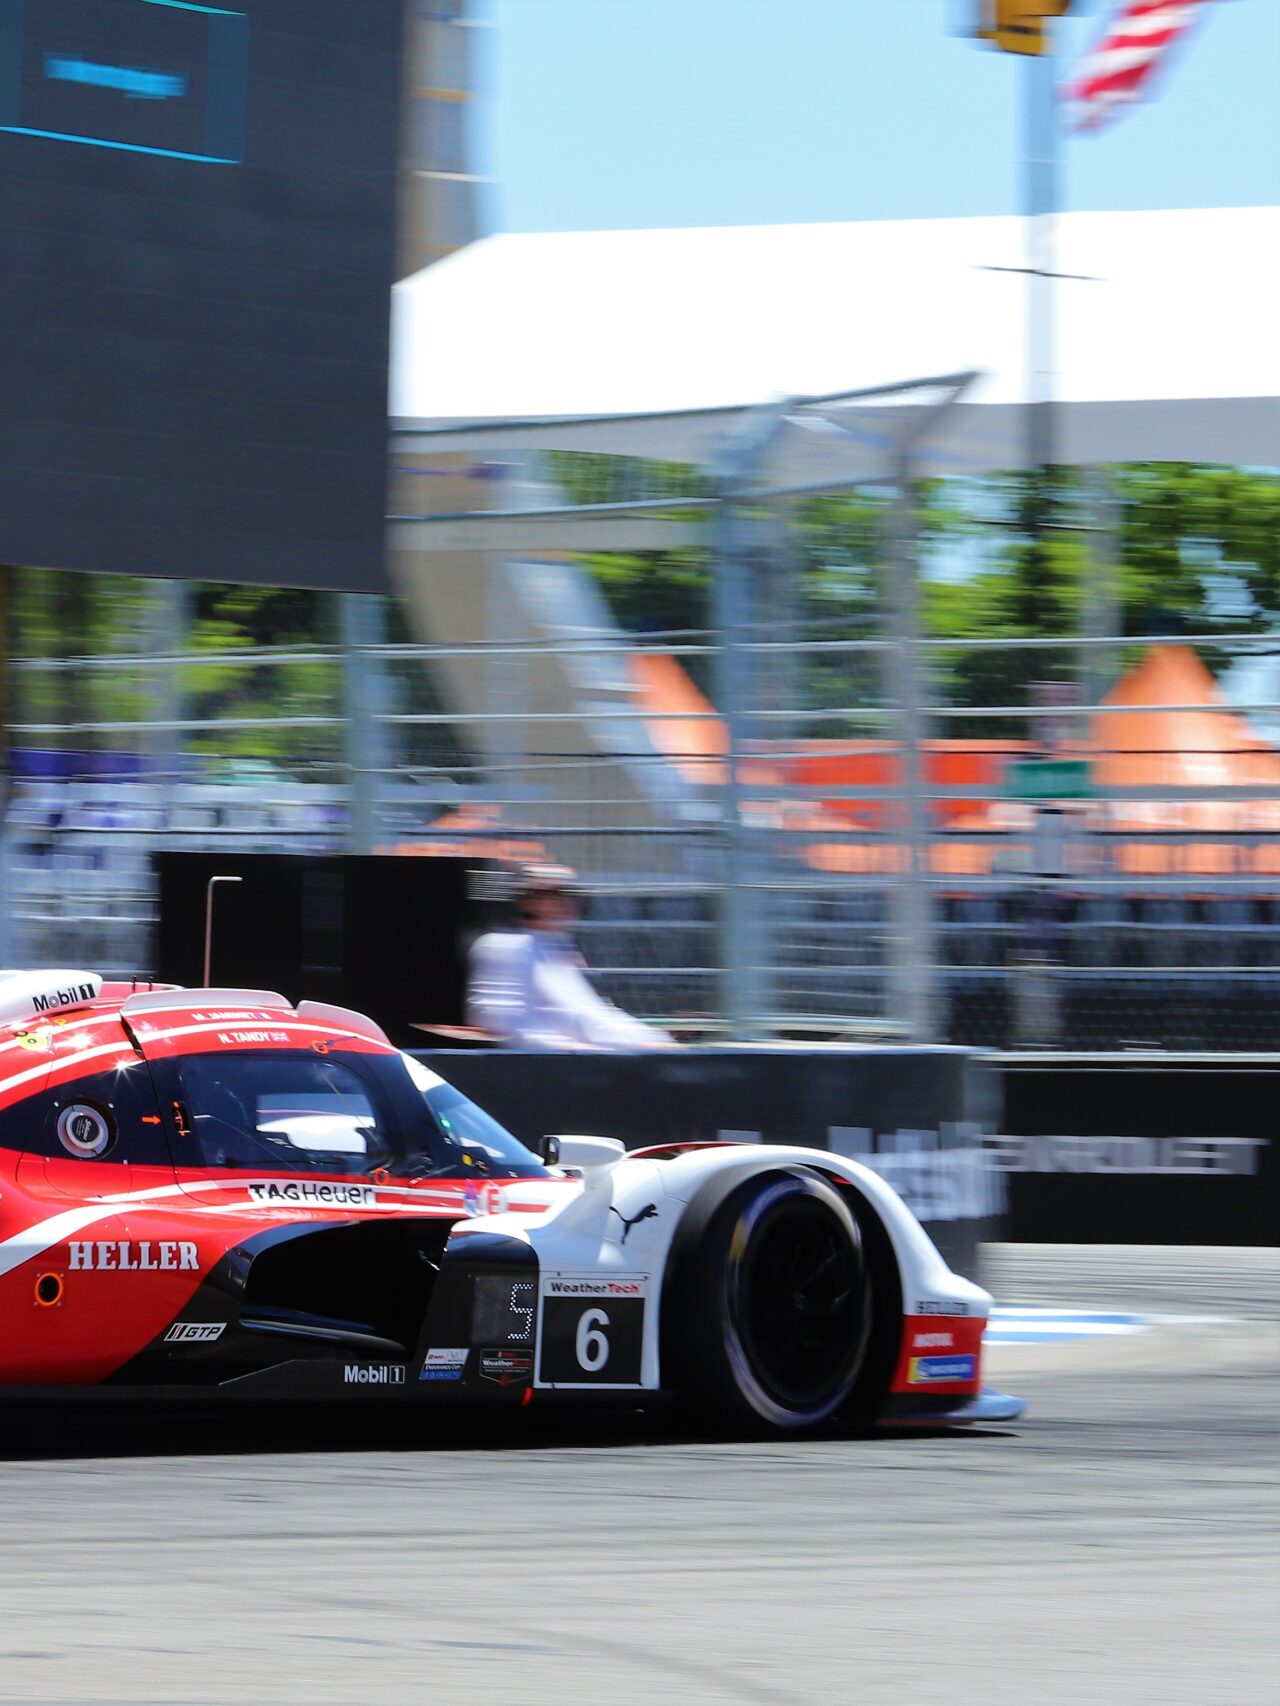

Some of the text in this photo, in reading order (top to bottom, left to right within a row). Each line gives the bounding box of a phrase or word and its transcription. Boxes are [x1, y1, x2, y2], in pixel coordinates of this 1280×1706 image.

[32, 988, 80, 1013] Mobil
[217, 1031, 271, 1044] N. TANDY
[68, 1241, 200, 1270] HELLER
[550, 1282, 641, 1294] WeatherTech
[184, 1326, 223, 1338] GTP
[575, 1307, 611, 1372] 6
[344, 1365, 388, 1383] Mobil
